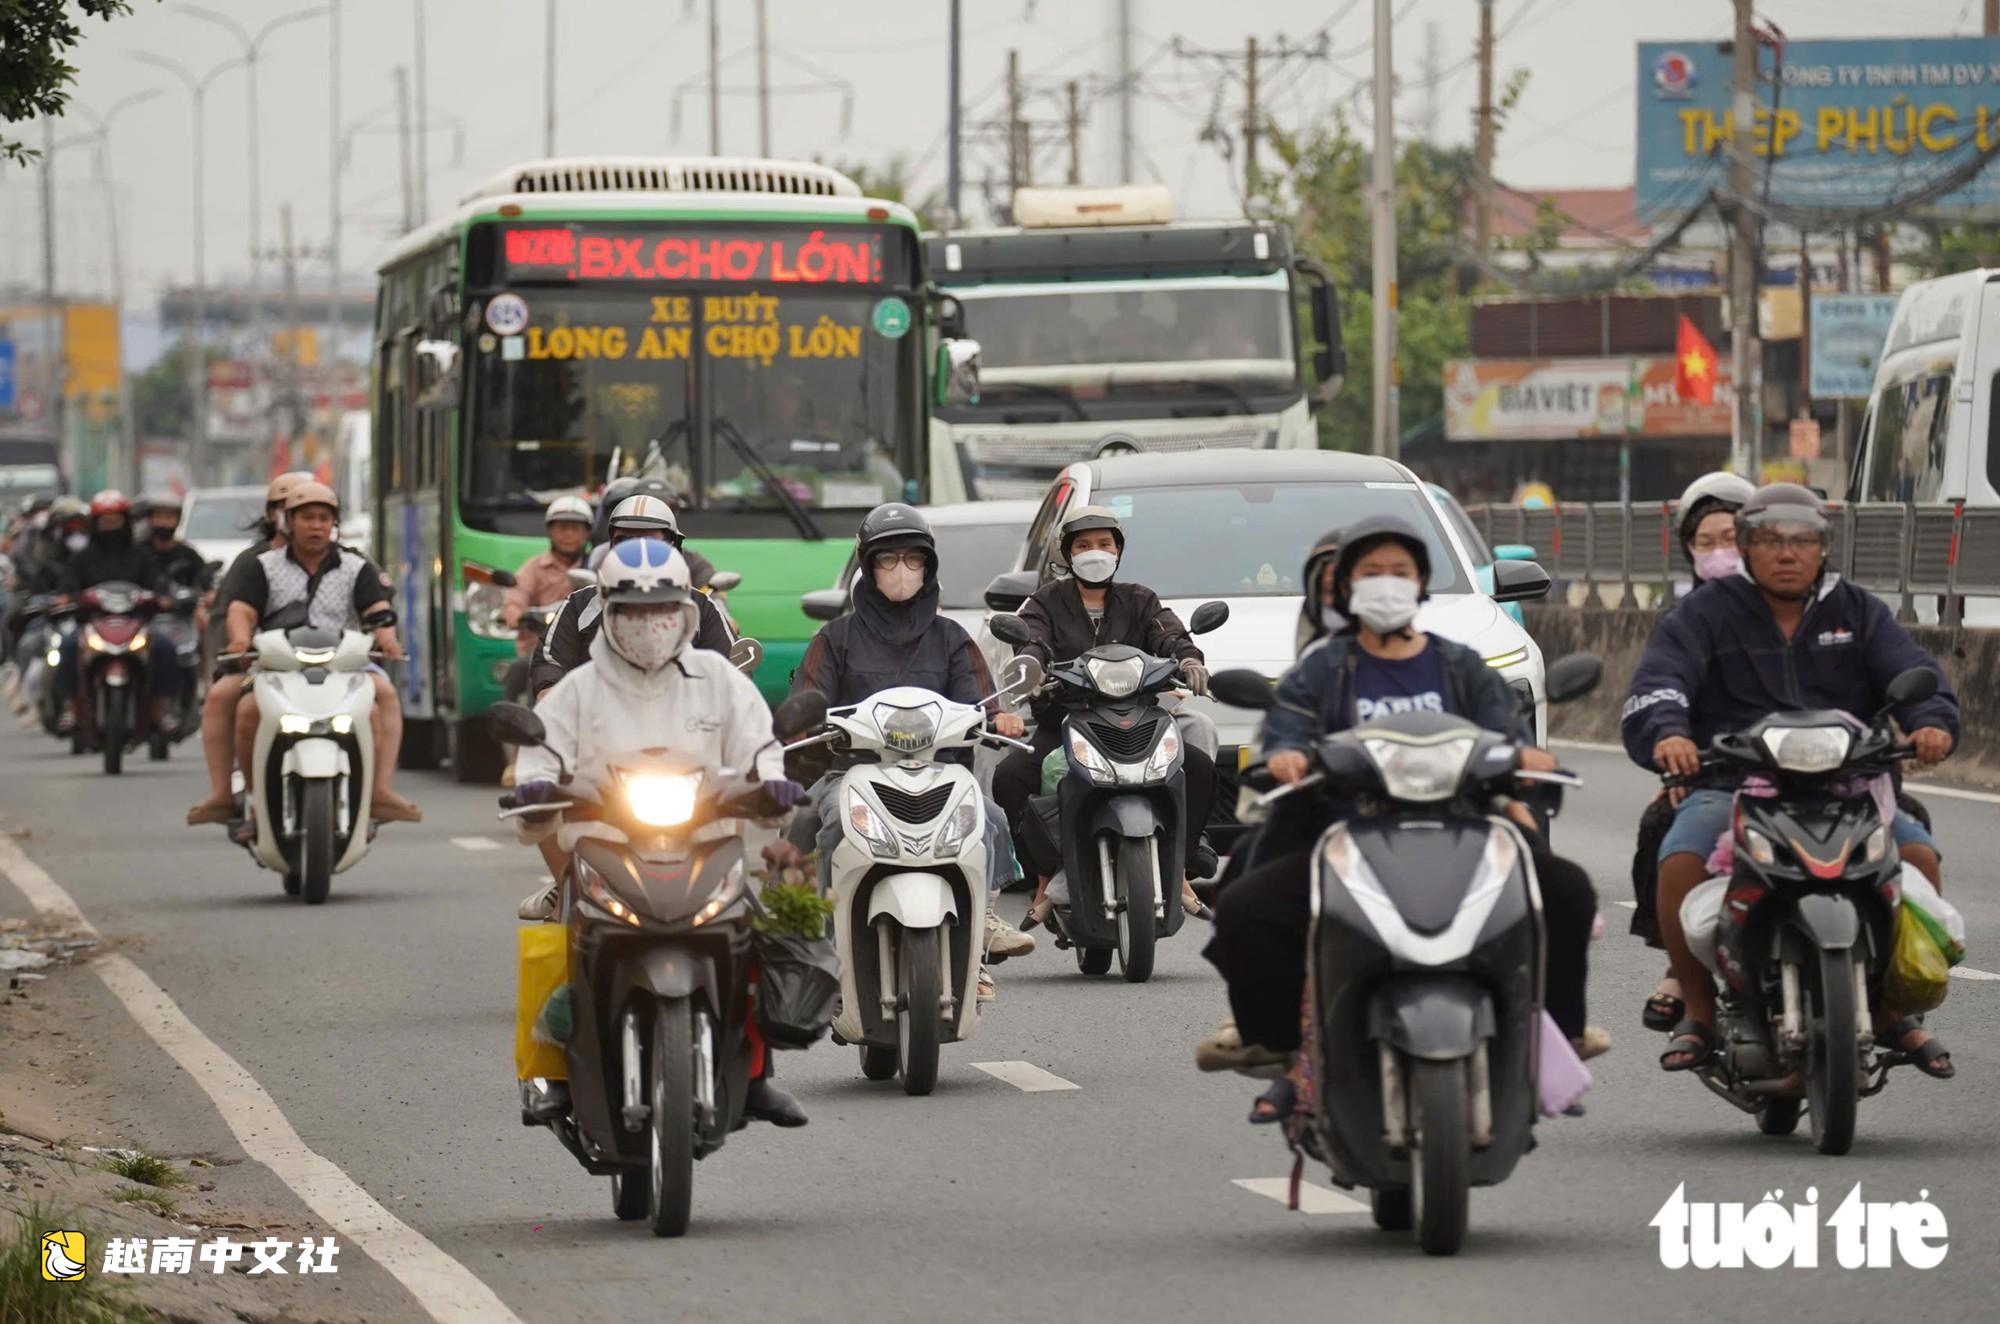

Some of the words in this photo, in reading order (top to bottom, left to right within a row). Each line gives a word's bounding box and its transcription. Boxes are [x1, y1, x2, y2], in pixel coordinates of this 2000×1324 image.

[1838, 64, 1864, 86] TY
[1816, 92, 1958, 155] PHÚC
[769, 229, 871, 284] LỚN
[651, 296, 693, 323] XE
[704, 290, 780, 323] BUÝT
[527, 325, 629, 361] LONG
[635, 326, 694, 361] AN
[704, 320, 781, 367] CHỢ
[1356, 691, 1444, 722] PARIS
